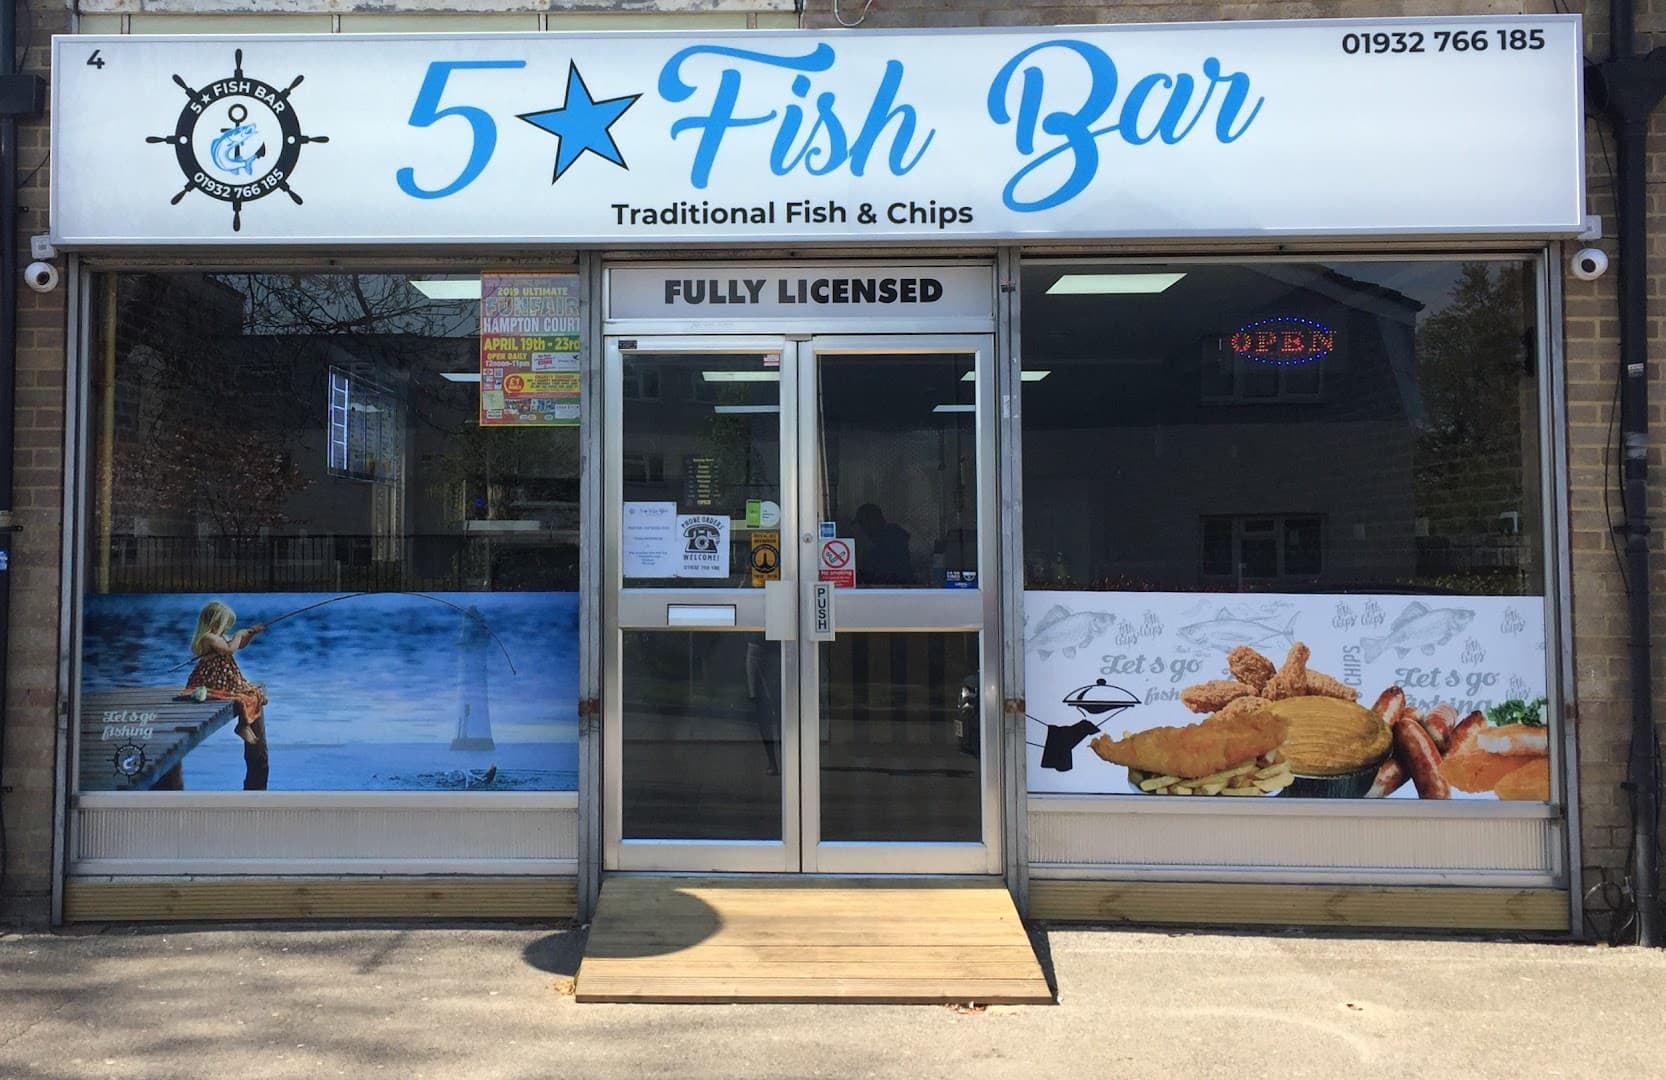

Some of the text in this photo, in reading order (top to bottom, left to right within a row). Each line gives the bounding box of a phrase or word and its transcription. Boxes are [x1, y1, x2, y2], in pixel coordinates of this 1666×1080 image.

[1342, 28, 1546, 54] 01932 766 185
[86, 50, 105, 70] 4
[190, 81, 286, 114] 5 FISH BAR
[396, 39, 1265, 213] 5 Fish Bar
[193, 168, 284, 199] 01932 766 185
[612, 201, 974, 226] Traditional Fish & Chips
[497, 287, 569, 296] 2019 ULTIMATE
[665, 277, 944, 305] FULLY LICENSED
[485, 296, 580, 317] FUNFAIR
[483, 317, 580, 333] HAMPTON COURT
[483, 337, 518, 351] APRIL
[521, 337, 546, 351] 19th
[816, 587, 827, 630] PUSH
[1169, 658, 1202, 683] go
[1343, 645, 1362, 687] CHIPS
[1465, 670, 1500, 697] go
